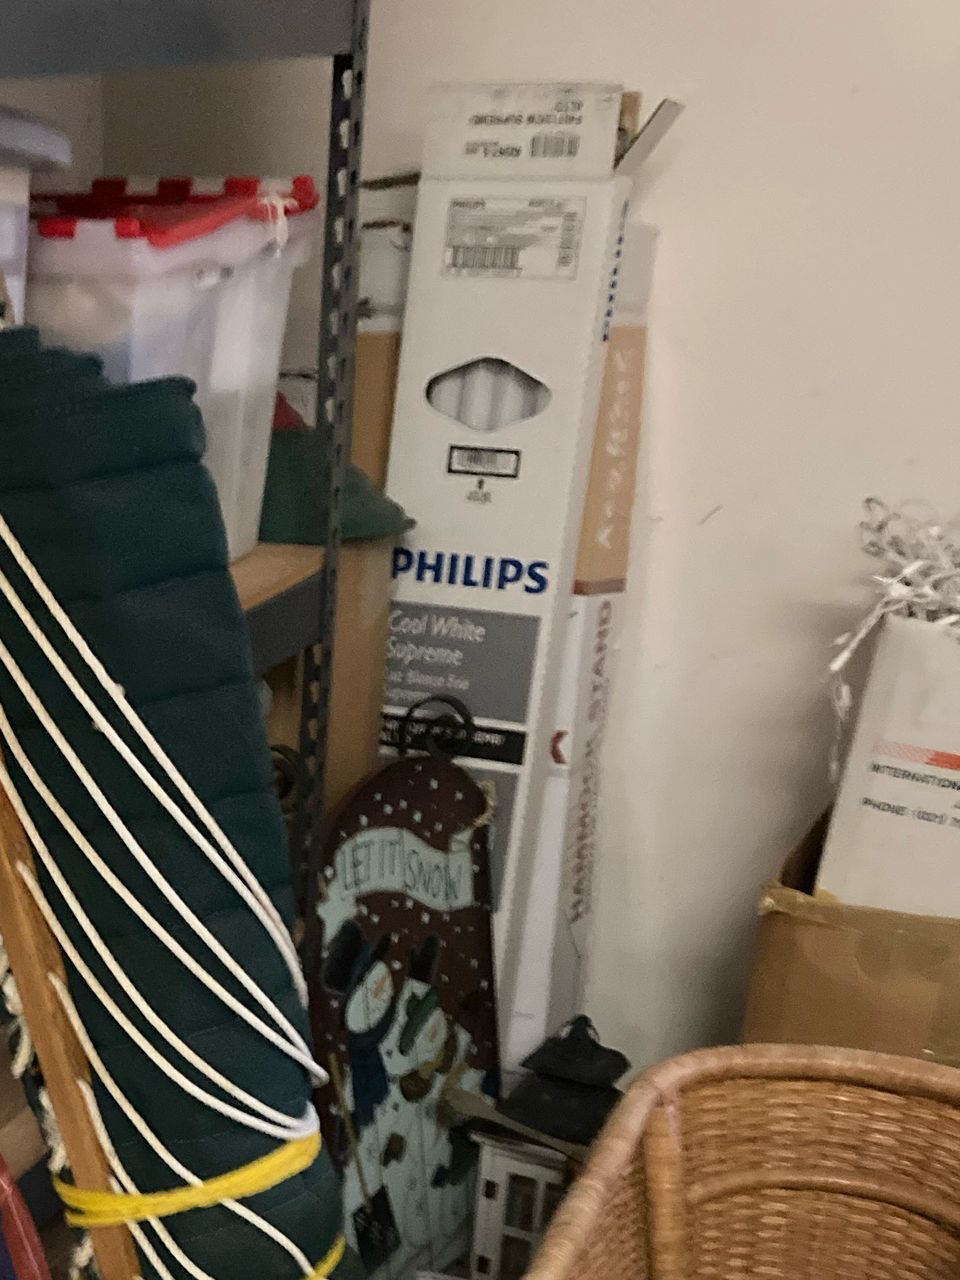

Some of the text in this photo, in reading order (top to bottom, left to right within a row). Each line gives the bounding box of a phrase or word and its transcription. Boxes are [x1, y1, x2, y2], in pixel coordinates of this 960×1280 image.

[391, 547, 550, 594] PHILIPS
[388, 610, 486, 643] Cool White
[386, 636, 463, 666] Supreme
[862, 797, 906, 816] PHONE
[403, 849, 461, 901] SNOW
